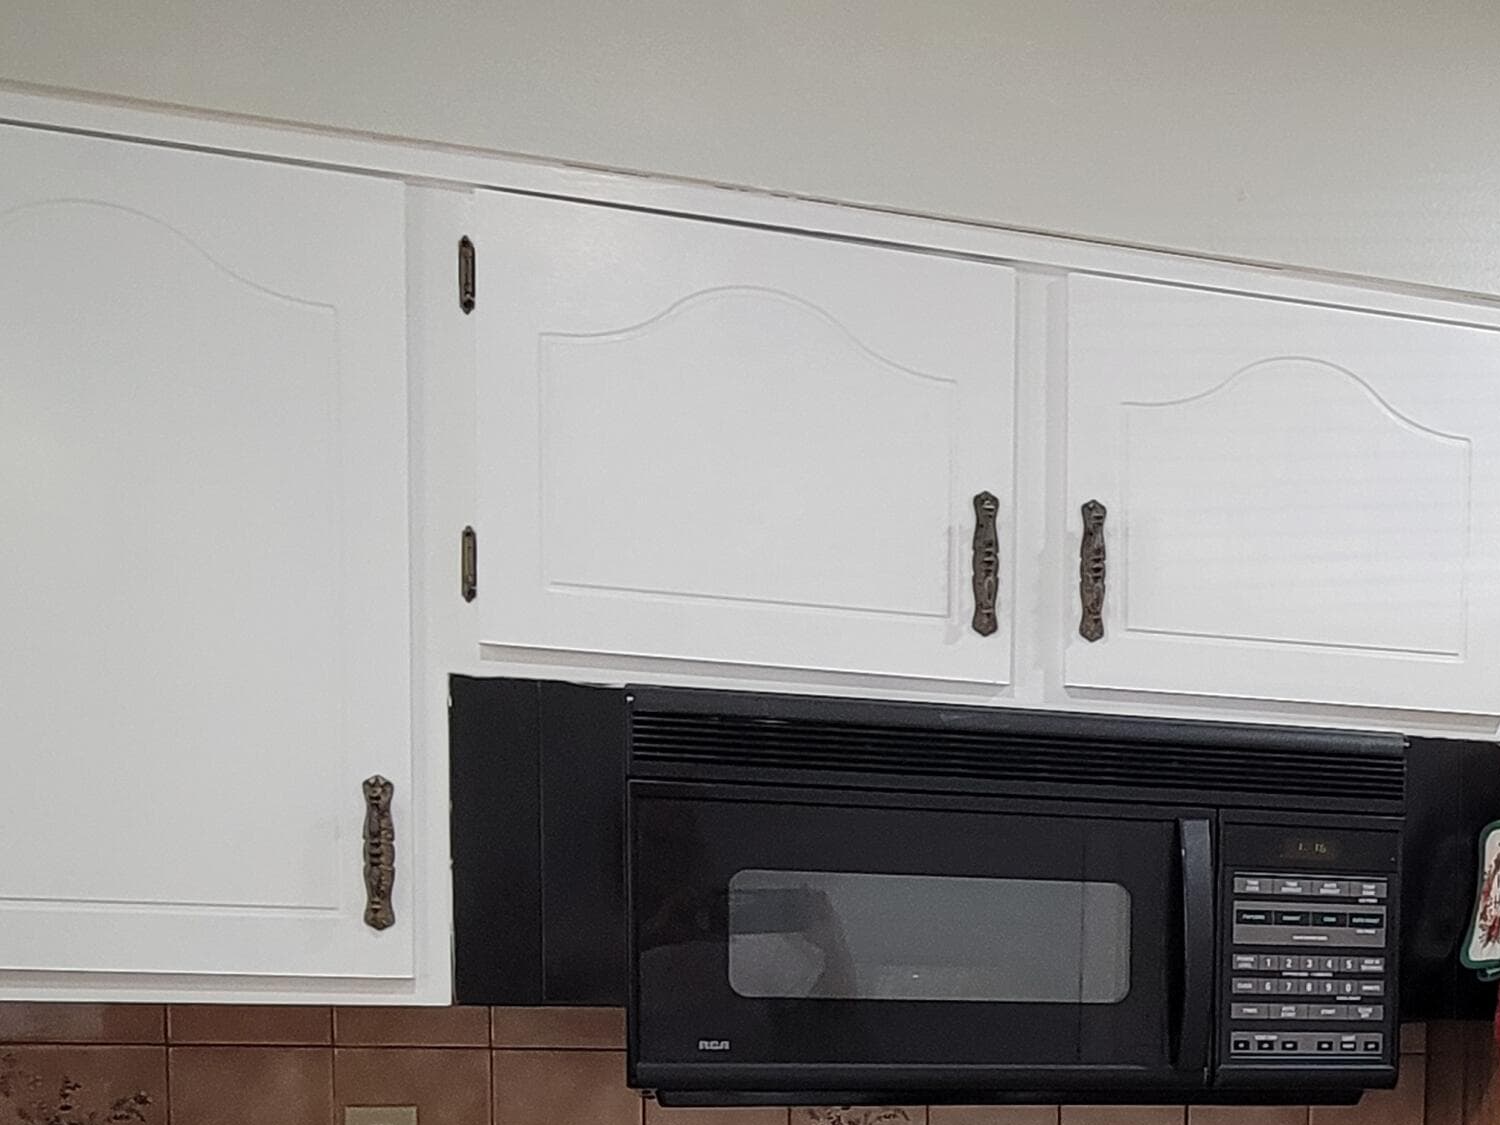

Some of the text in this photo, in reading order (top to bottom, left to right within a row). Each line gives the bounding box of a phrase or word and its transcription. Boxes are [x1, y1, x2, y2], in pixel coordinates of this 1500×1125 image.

[1266, 958, 1271, 968] 1
[1286, 958, 1292, 969] 2
[1307, 959, 1313, 969] 3
[1326, 959, 1332, 969] 4
[1346, 959, 1352, 969] 5
[1265, 982, 1271, 991] 6
[1286, 982, 1292, 991] 7
[1306, 982, 1312, 992] 8
[1326, 983, 1332, 992] 9
[1345, 983, 1352, 992] 0
[699, 1040, 730, 1050] RCA
